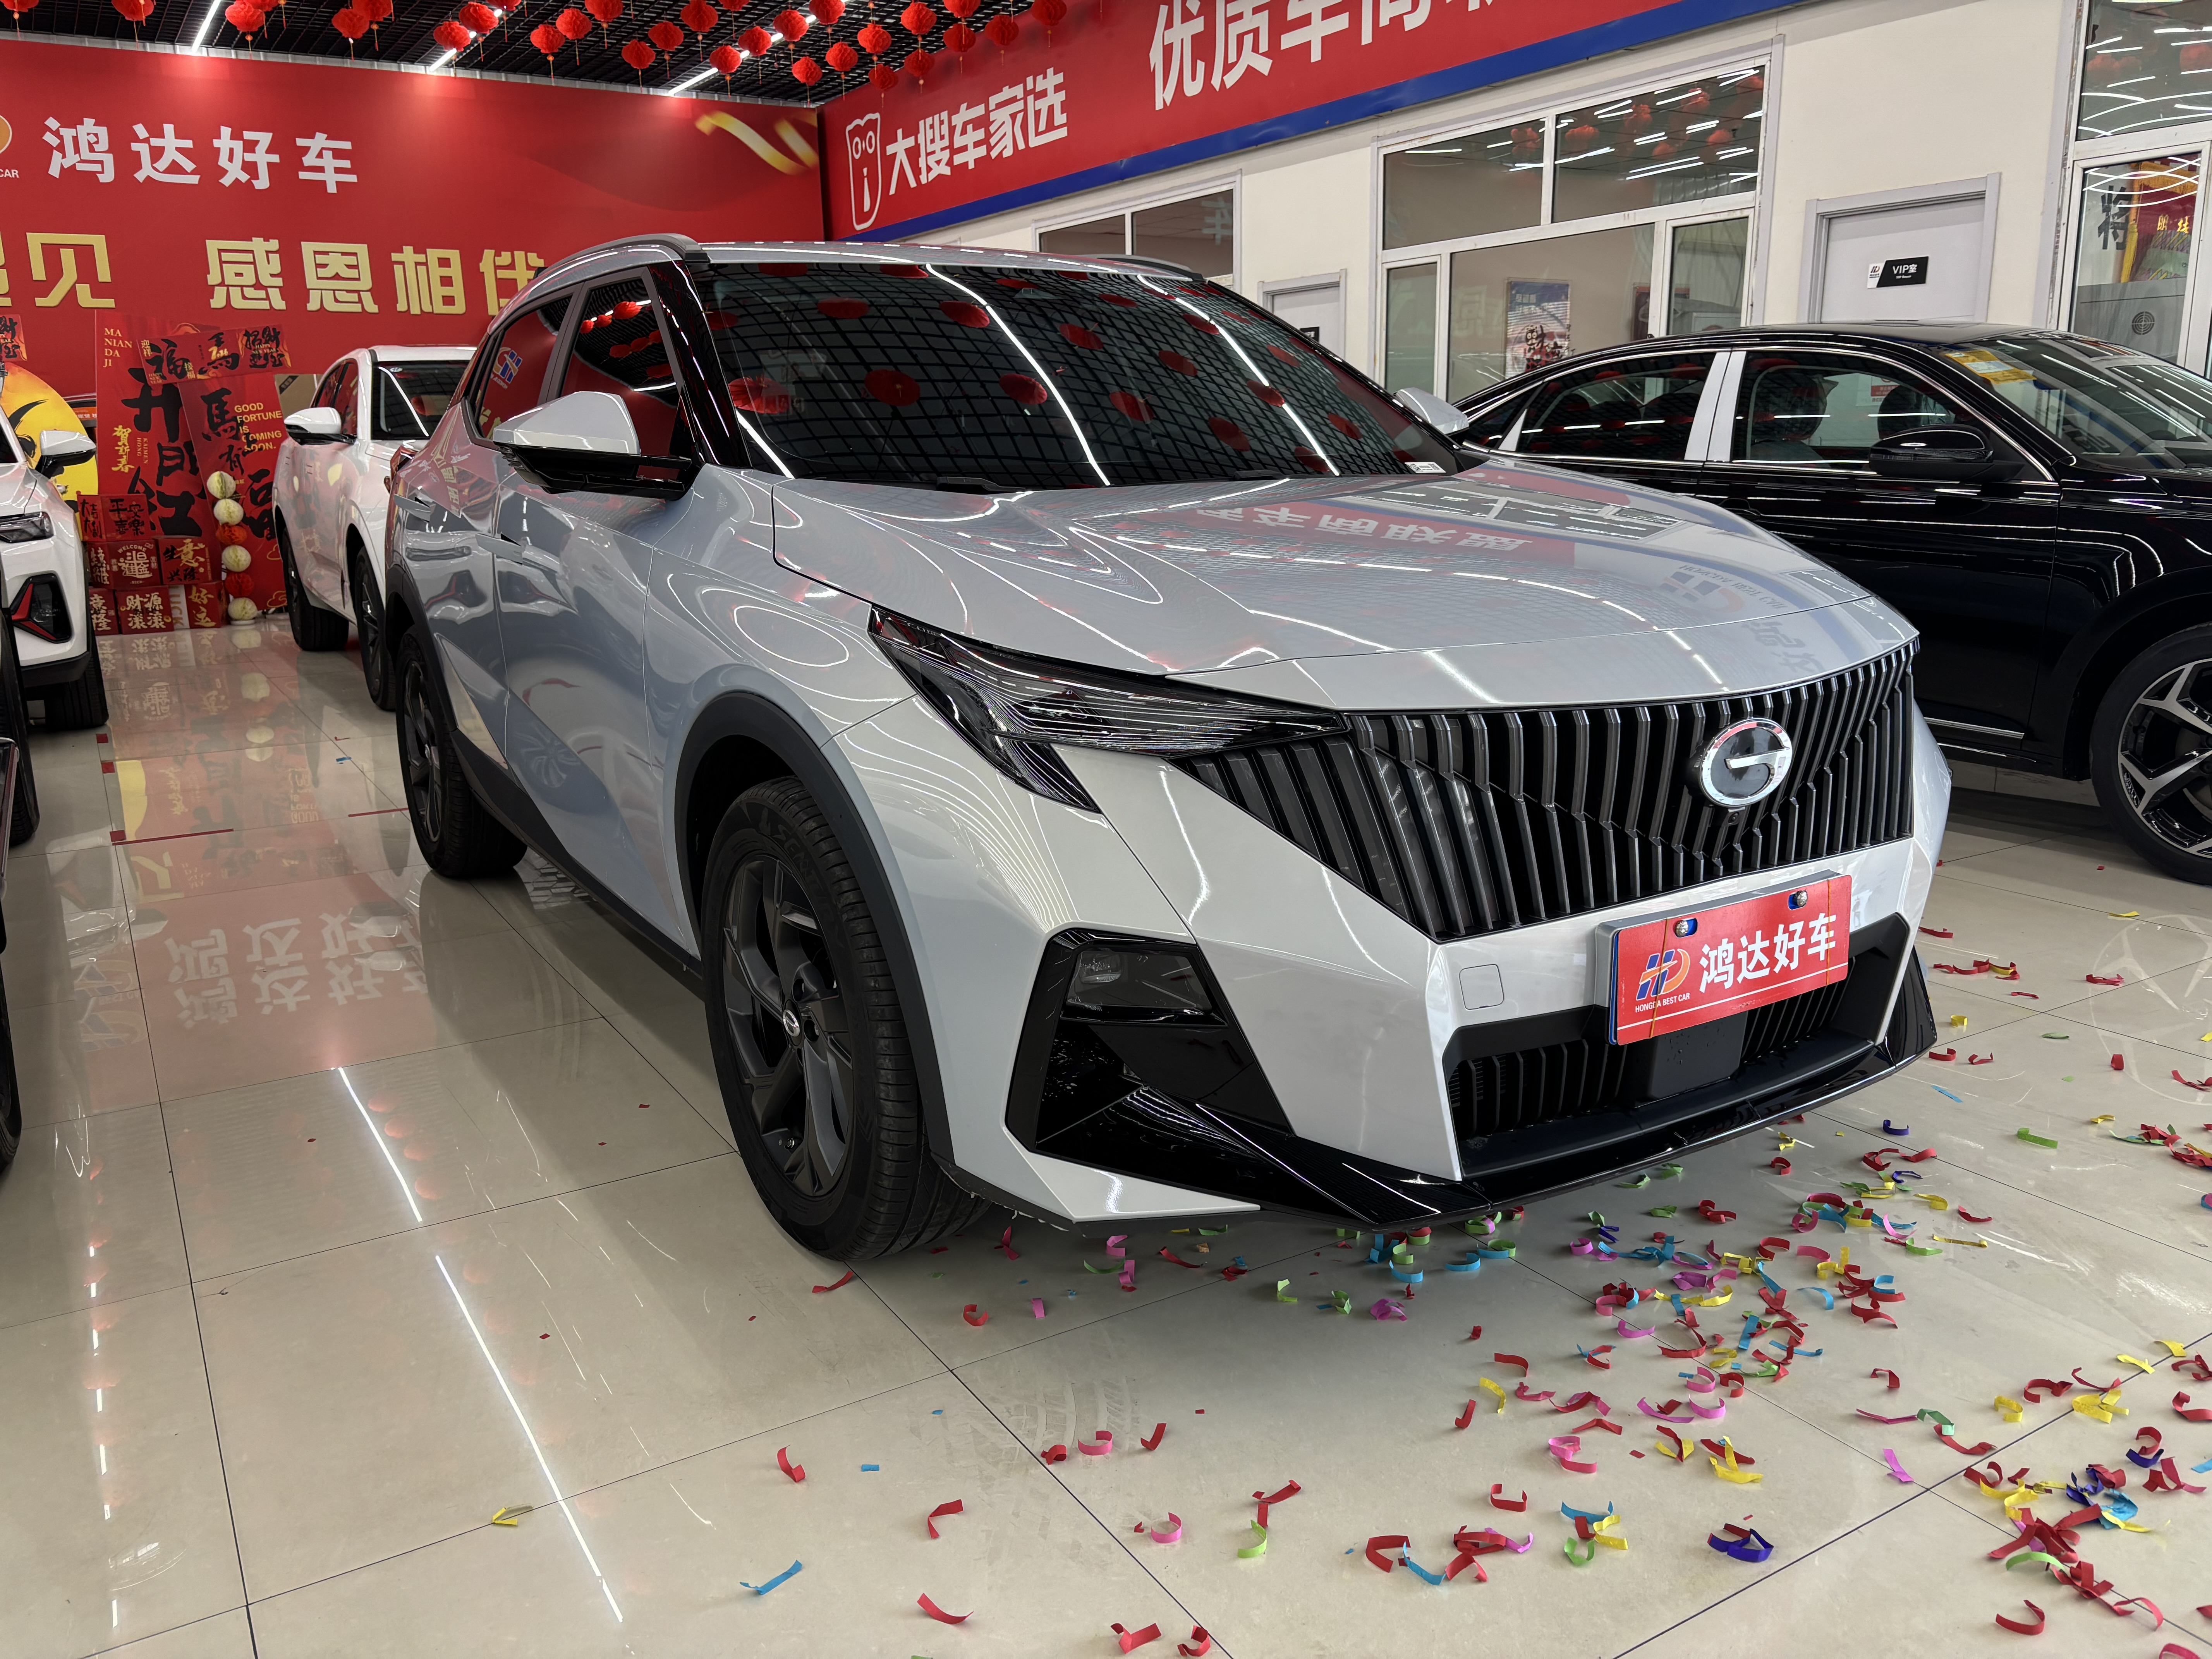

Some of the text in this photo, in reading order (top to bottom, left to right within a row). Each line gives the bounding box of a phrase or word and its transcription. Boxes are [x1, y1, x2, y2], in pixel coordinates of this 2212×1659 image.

[1149, 0, 1493, 110] 优质车
[886, 67, 1068, 195] 大搜车家选
[42, 117, 357, 193] 鸿达好车
[0, 232, 115, 308] 见
[1893, 264, 1917, 274] VIP室
[104, 328, 122, 337] MA
[104, 338, 132, 348] NIAN
[105, 349, 120, 357] DA
[103, 359, 112, 368] JI
[234, 402, 264, 413] GOOD
[237, 410, 283, 423] FORTUNE
[239, 426, 249, 434] IS
[242, 431, 282, 443] COMING
[244, 442, 276, 452] SOON.
[117, 544, 147, 554] WELCOME
[1699, 913, 1837, 993] 鸿达好车
[1635, 993, 1690, 1013] HONGDA BEST CAR
